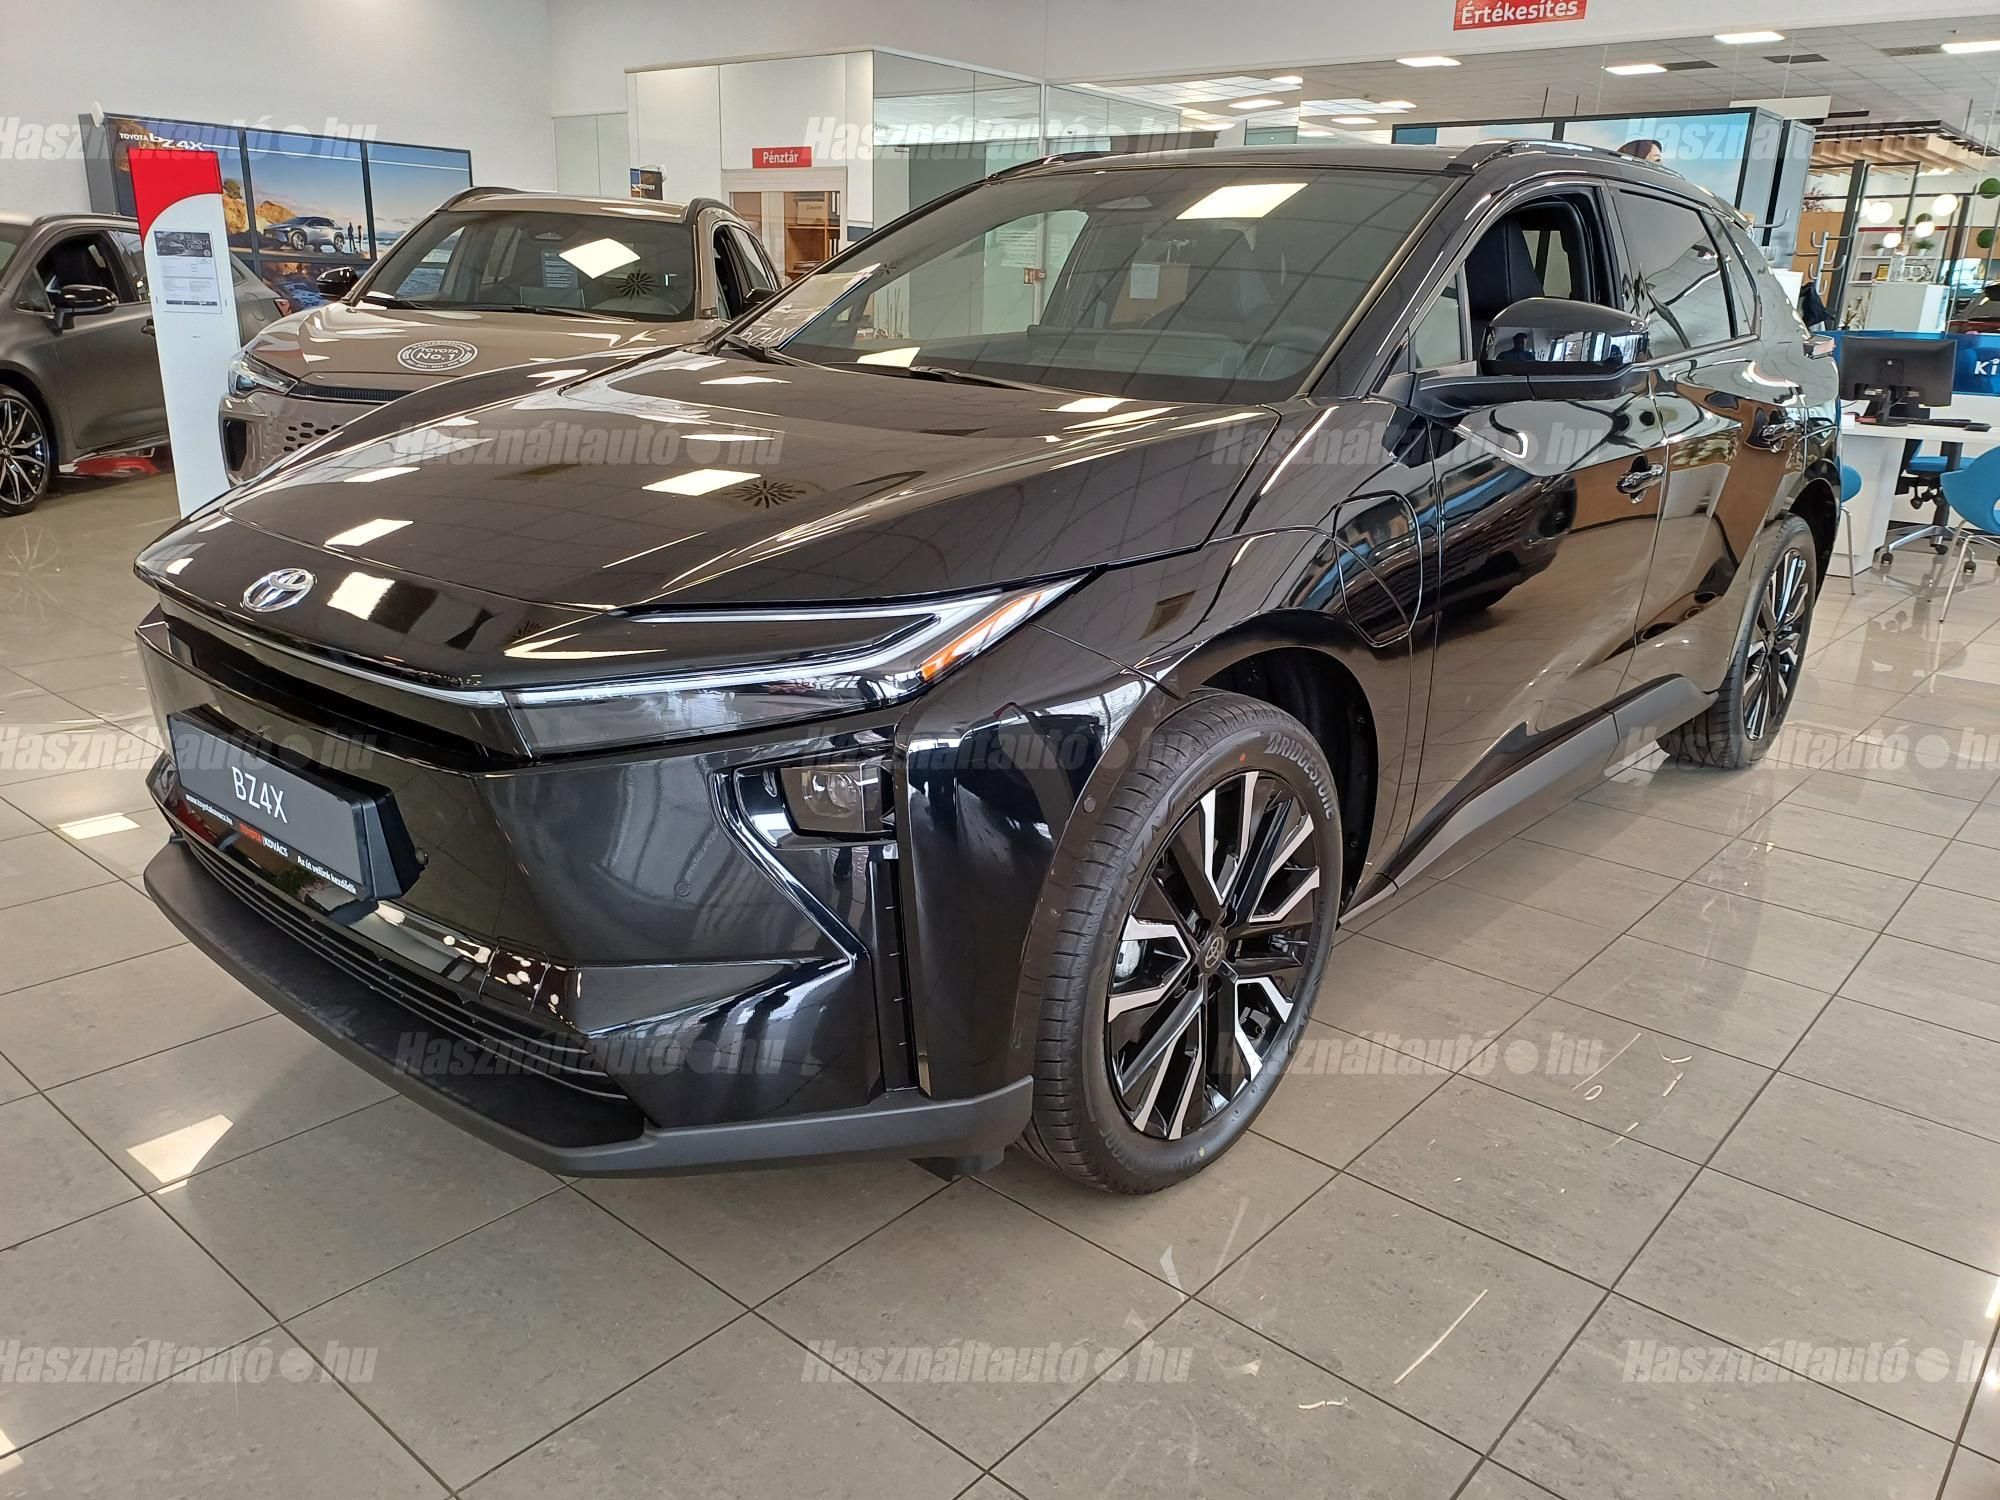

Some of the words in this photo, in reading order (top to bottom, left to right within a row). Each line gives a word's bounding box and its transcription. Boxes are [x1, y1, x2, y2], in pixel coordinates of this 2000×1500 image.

[119, 132, 149, 142] TOYOTA
[763, 150, 799, 164] Pénztár
[448, 353, 456, 361] 1
[1264, 731, 1336, 820] BRIDGESTONE
[231, 766, 288, 824] BZ4X
